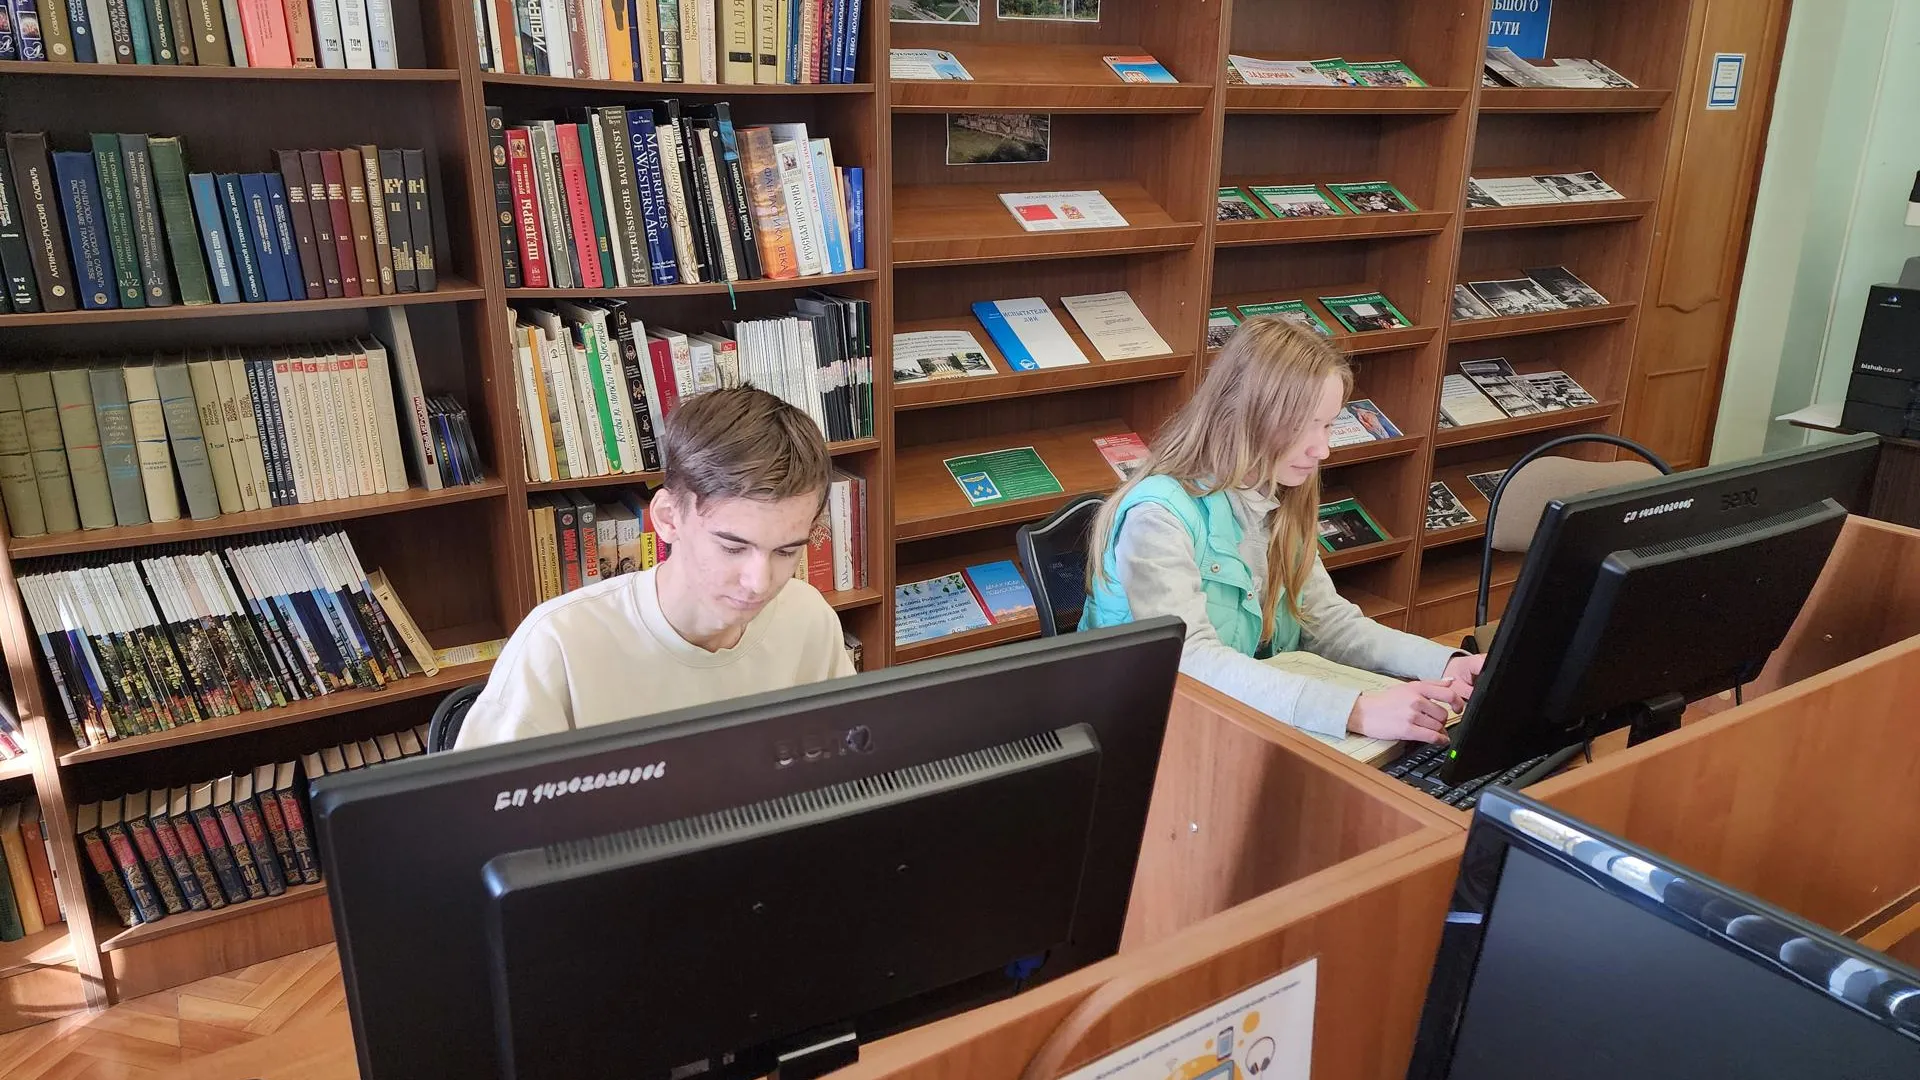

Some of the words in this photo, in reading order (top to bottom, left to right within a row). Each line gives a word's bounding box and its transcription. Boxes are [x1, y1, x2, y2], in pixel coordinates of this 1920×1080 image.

[632, 133, 644, 151] OF
[672, 116, 683, 144] BRULLOV
[540, 146, 549, 169] ЛАВРА
[613, 128, 628, 184] BAUKUNST
[663, 133, 682, 194] Кипренский
[677, 144, 686, 161] KARL
[30, 166, 43, 199] СЛОВАРЬ
[515, 169, 524, 195] русской
[522, 162, 531, 194] живописи
[635, 150, 654, 215] WESTERN
[645, 132, 668, 229] MASTERPIECES
[730, 161, 747, 213] Григорович
[544, 171, 563, 251] АЛЕКСАНДРО-НЕВСКАЯ
[675, 195, 689, 227] Орест
[791, 183, 806, 222] ИСТОРИЯ
[521, 197, 539, 260] ШЕДЕВРЫ
[622, 188, 640, 263] ALTRUSSISCHE
[645, 217, 659, 244] ART
[740, 214, 753, 240] Юрий
[762, 167, 783, 241] ФАНТАСТИКА
[777, 245, 788, 272] ВЕКА
[38, 203, 59, 278] ЛАТИНСКО-РУССКИЙ
[799, 224, 813, 260] РУССКАЯ
[120, 279, 139, 287] M-Z
[249, 273, 259, 297] СЛОВАРЬ
[1003, 308, 1048, 318] ИСПЫТАТЕЛИ
[594, 322, 610, 361] Slovensku
[308, 364, 314, 372] 6
[332, 363, 338, 371] 8
[1861, 363, 1882, 371] bizhub
[248, 369, 260, 402] ИСКУССТВА
[257, 368, 268, 401] ИСКУССТВА
[266, 367, 278, 401] ИСКУССТВА
[605, 376, 618, 405] storočia
[273, 403, 288, 458] ИЗОБРАЗИТЕЛЬНОГО
[415, 396, 427, 433] ИЕРУСАЛИМ
[613, 416, 626, 443] Kresba
[255, 405, 270, 460] ИЗОБРАЗИТЕЛЬНОГО
[264, 404, 279, 459] ИЗОБРАЗИТЕЛЬНОГО
[423, 433, 432, 455] НОВЫЙ
[266, 462, 275, 482] ШКОЛА
[275, 461, 284, 481] ШКОЛА
[284, 459, 293, 480] ШКОЛА
[281, 490, 287, 498] 2
[290, 489, 296, 497] 3
[583, 527, 597, 576] ВЕРМАХТ
[494, 788, 528, 812] БП
